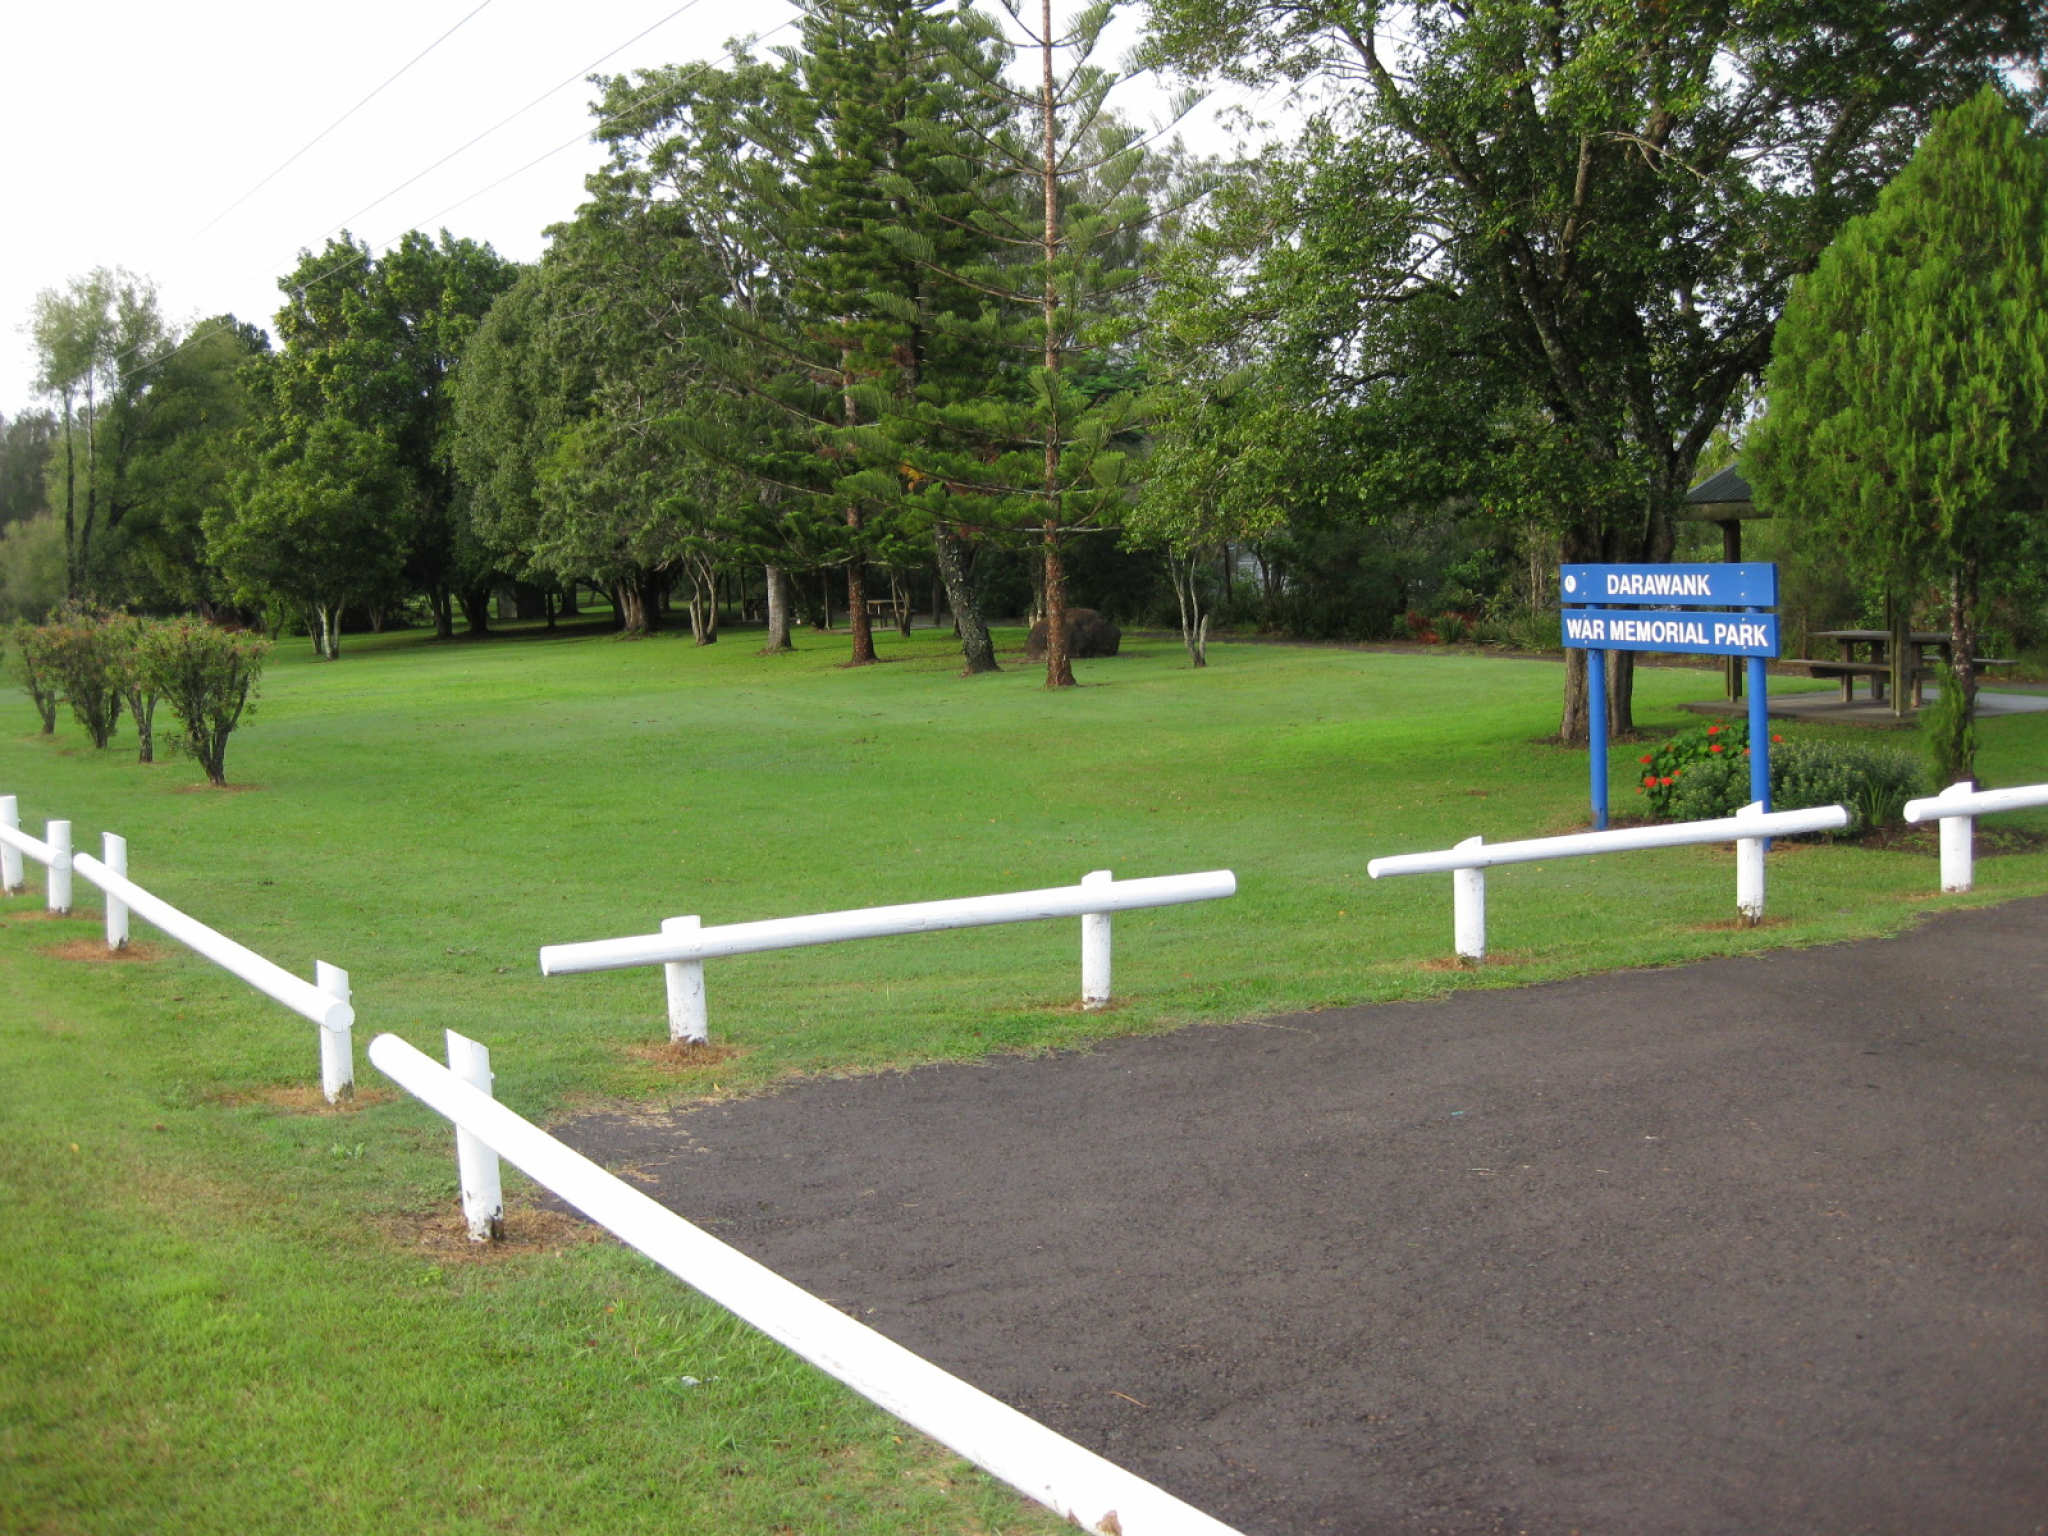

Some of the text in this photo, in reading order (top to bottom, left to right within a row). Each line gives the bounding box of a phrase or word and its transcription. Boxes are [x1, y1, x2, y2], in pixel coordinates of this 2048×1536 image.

[1607, 574, 1711, 596] DARAWANK
[1566, 618, 1769, 647] WAR MEMORIAL PARK
